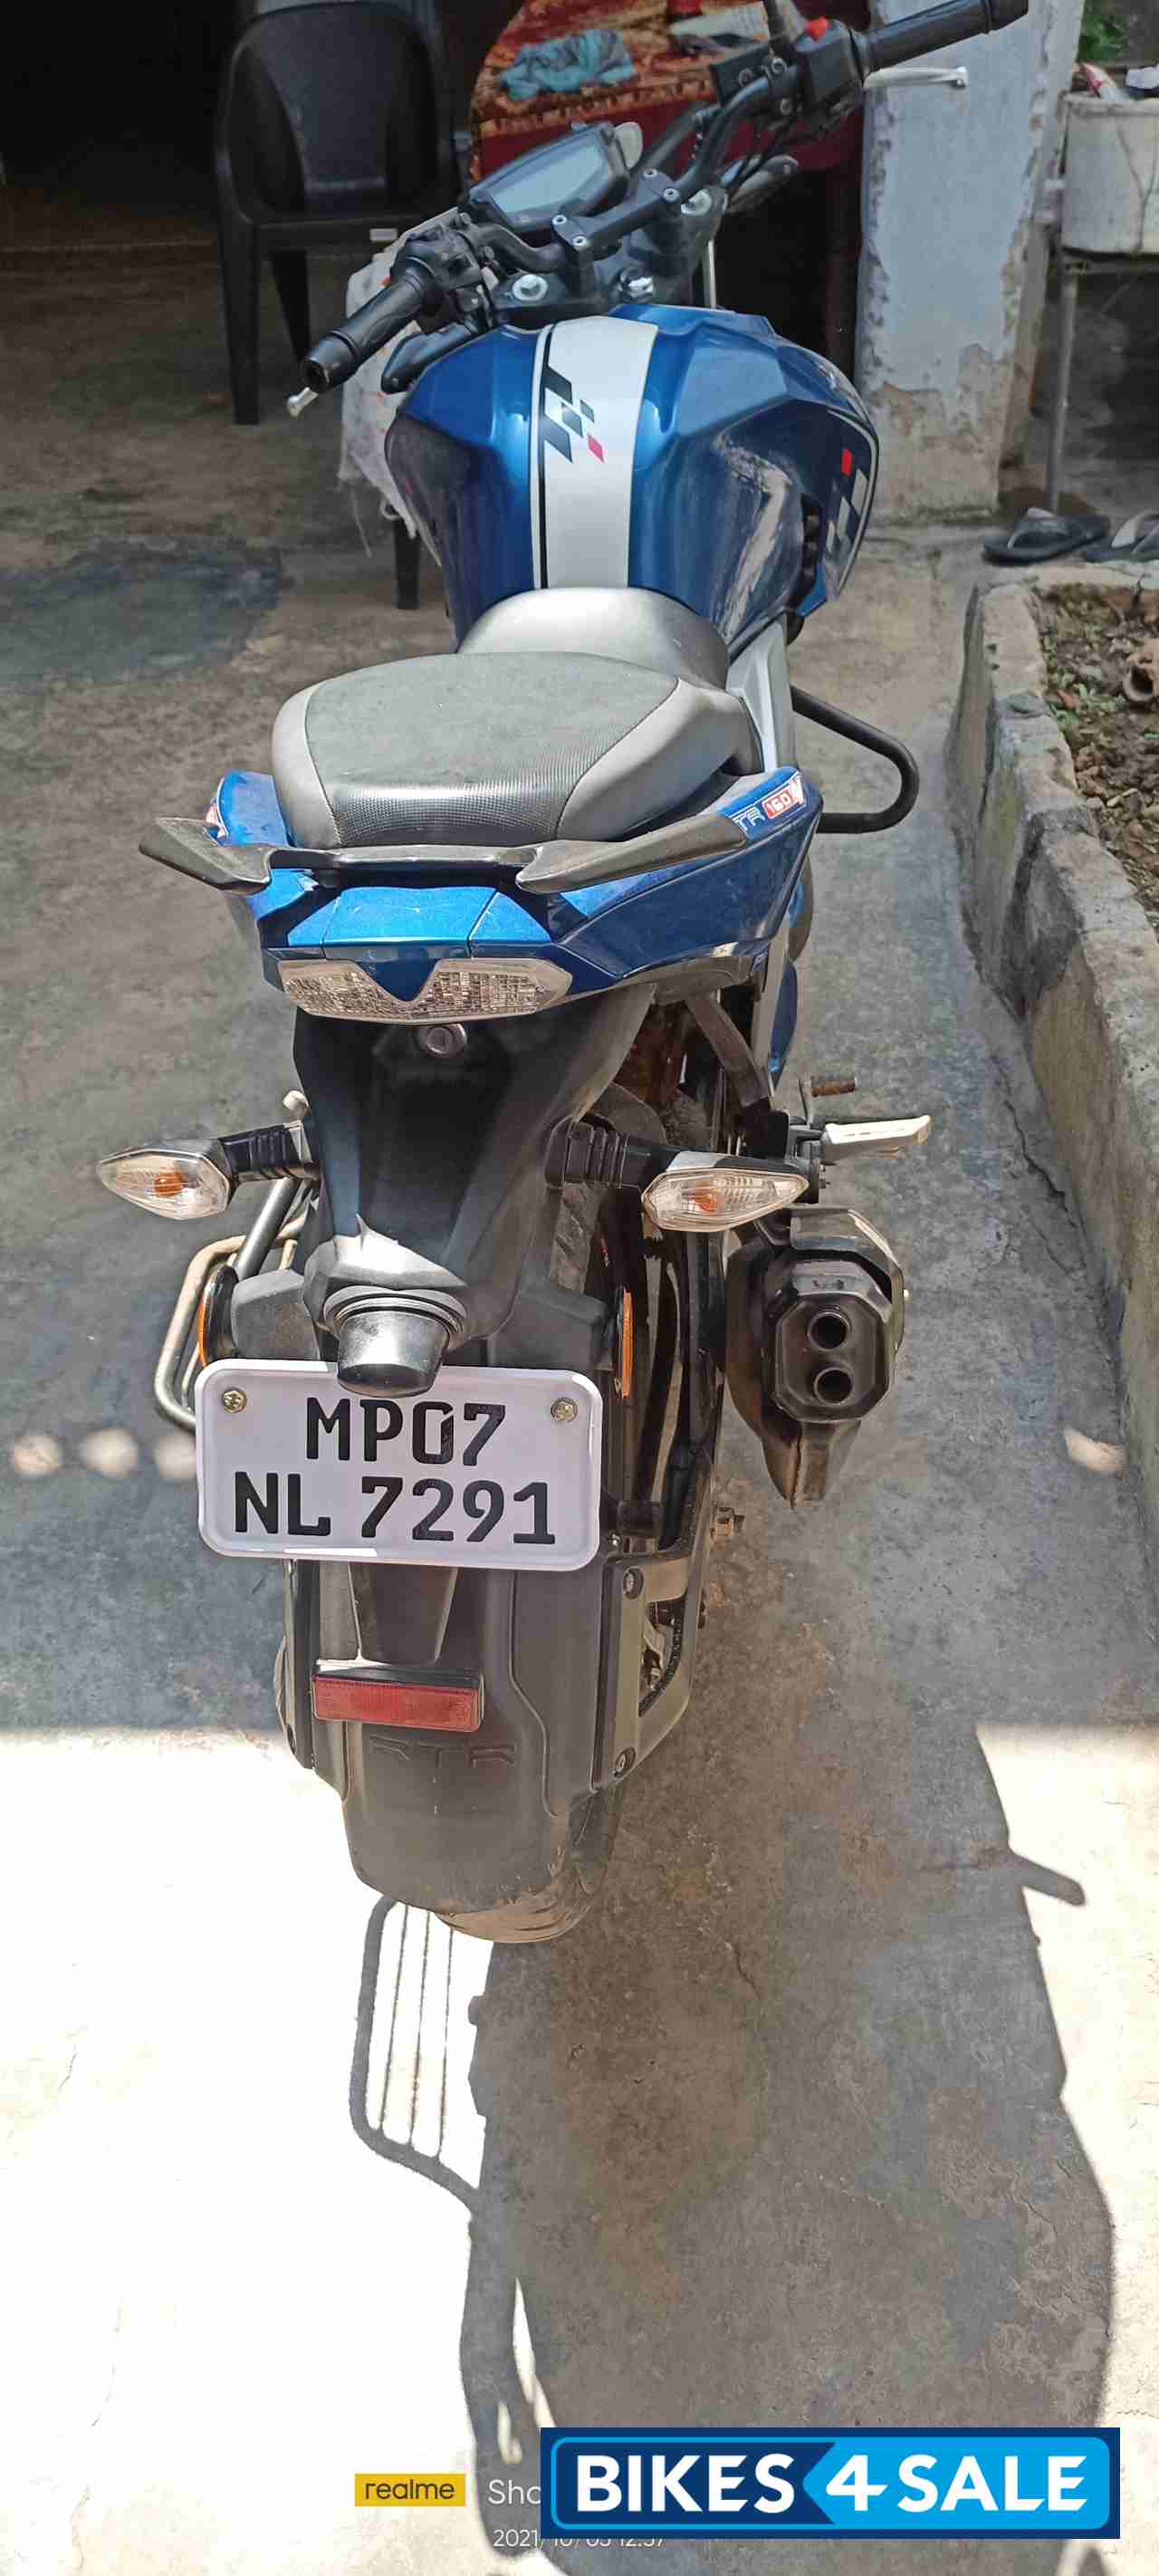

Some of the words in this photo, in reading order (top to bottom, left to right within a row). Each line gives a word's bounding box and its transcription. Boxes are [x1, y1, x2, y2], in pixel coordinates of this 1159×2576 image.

[305, 1397, 507, 1466] MP07
[235, 1471, 331, 1537] NL
[360, 1475, 556, 1545] 7291
